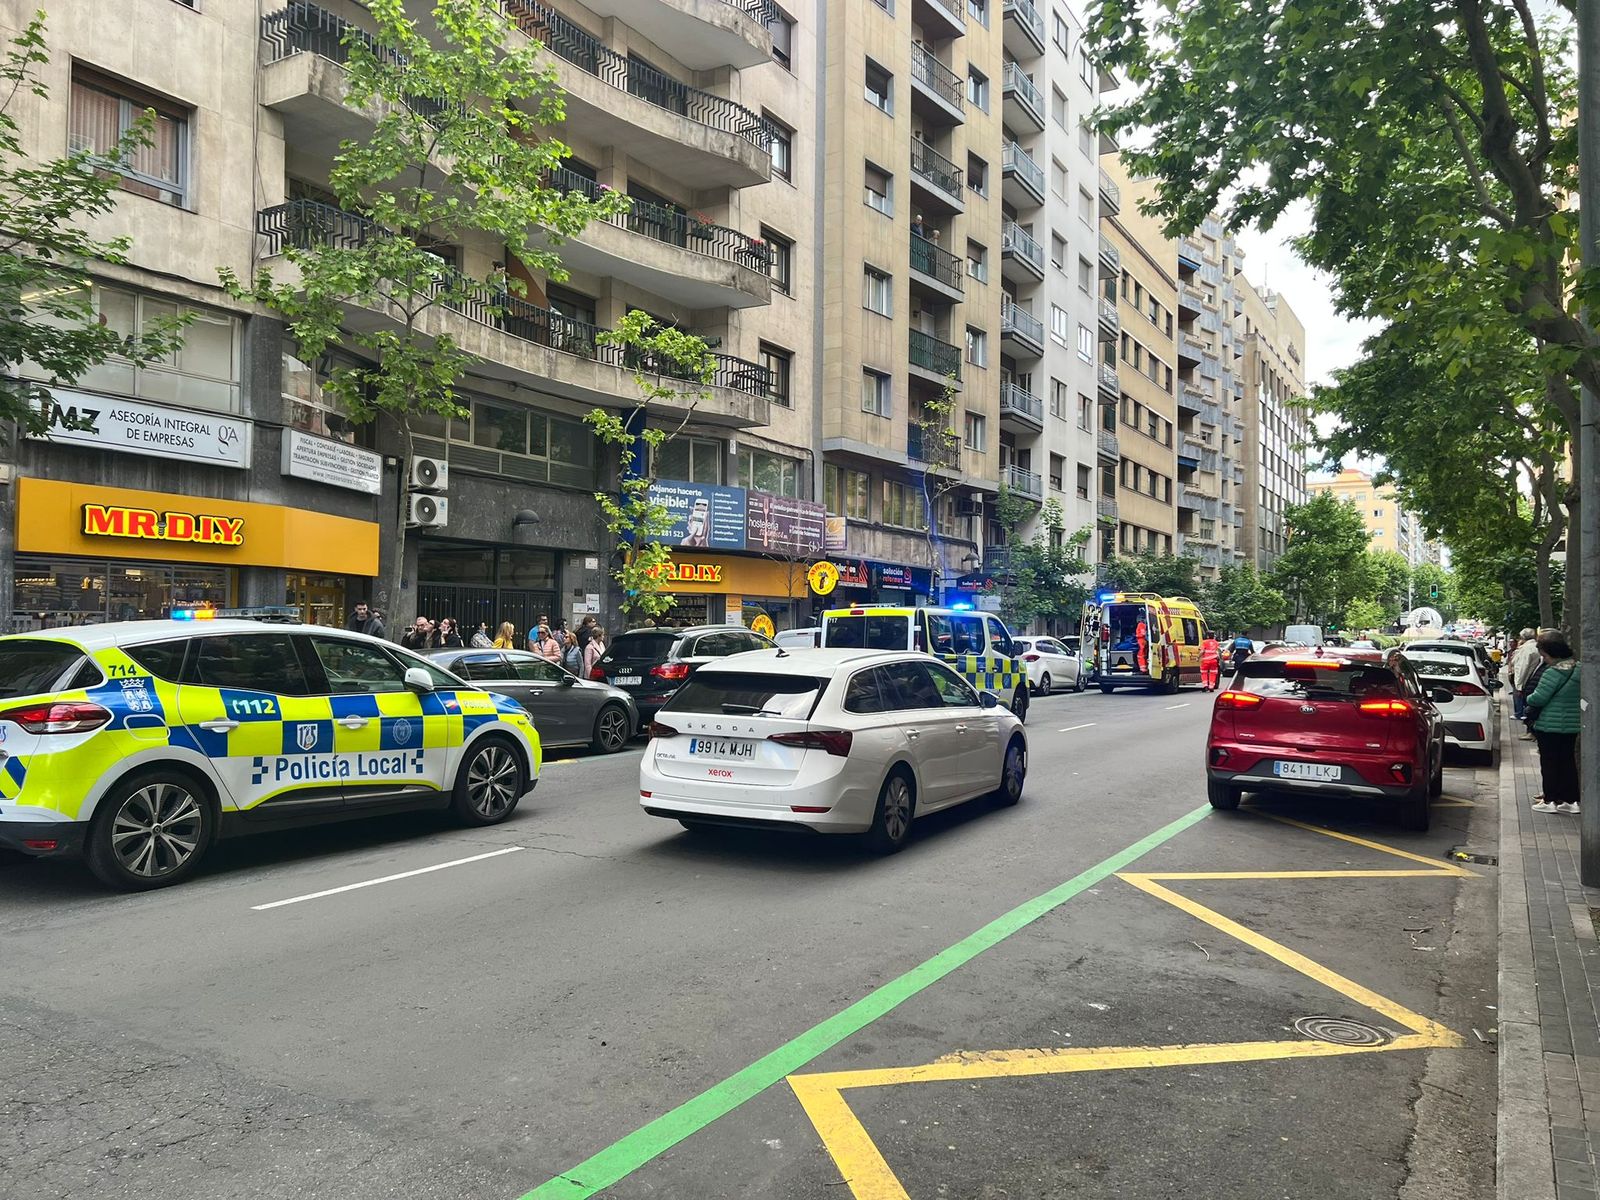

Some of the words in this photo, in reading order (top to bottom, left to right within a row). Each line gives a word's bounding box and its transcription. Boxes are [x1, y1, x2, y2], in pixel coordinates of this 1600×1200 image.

[109, 409, 161, 428] ASESORÍA
[164, 418, 211, 436] INTEGRAL
[126, 427, 140, 440] DE
[143, 430, 195, 448] EMPRESAS
[649, 484, 677, 494] Déjanos
[677, 487, 702, 497] hacerte
[649, 494, 688, 509] visible!
[108, 664, 137, 677] 714
[238, 699, 276, 714] 112
[697, 740, 726, 755] 9914
[729, 742, 753, 757] MJH
[275, 754, 350, 781] Policía
[358, 752, 406, 776] Local
[708, 768, 732, 778] xerox
[1282, 763, 1312, 776] 8411
[1315, 764, 1340, 778] LKJ
